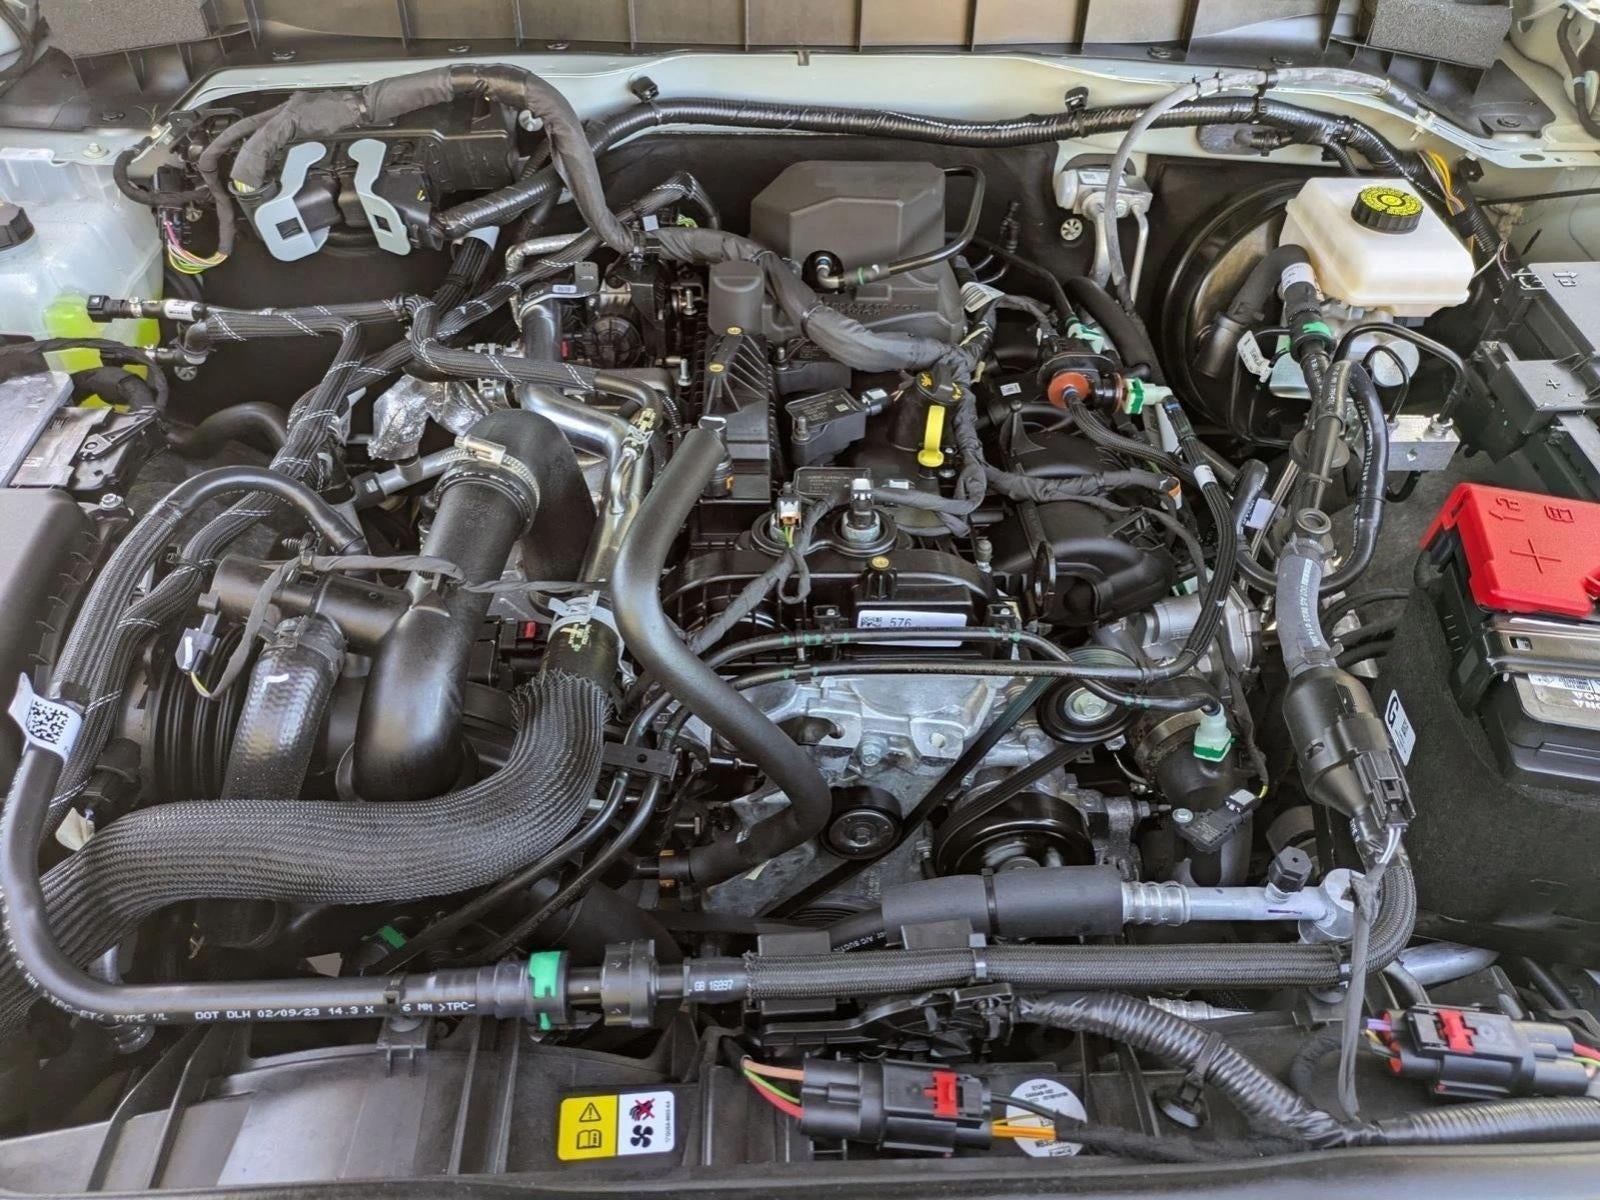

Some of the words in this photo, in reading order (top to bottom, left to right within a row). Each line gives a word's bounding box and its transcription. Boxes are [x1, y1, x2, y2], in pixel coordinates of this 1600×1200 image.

[889, 617, 912, 628] 576
[112, 1012, 146, 1023] TYPE
[195, 1010, 219, 1020] DOT
[257, 1007, 320, 1018] 02/09/23
[327, 1006, 359, 1016] 14.3
[365, 1005, 375, 1015] X
[417, 1002, 433, 1012] MM
